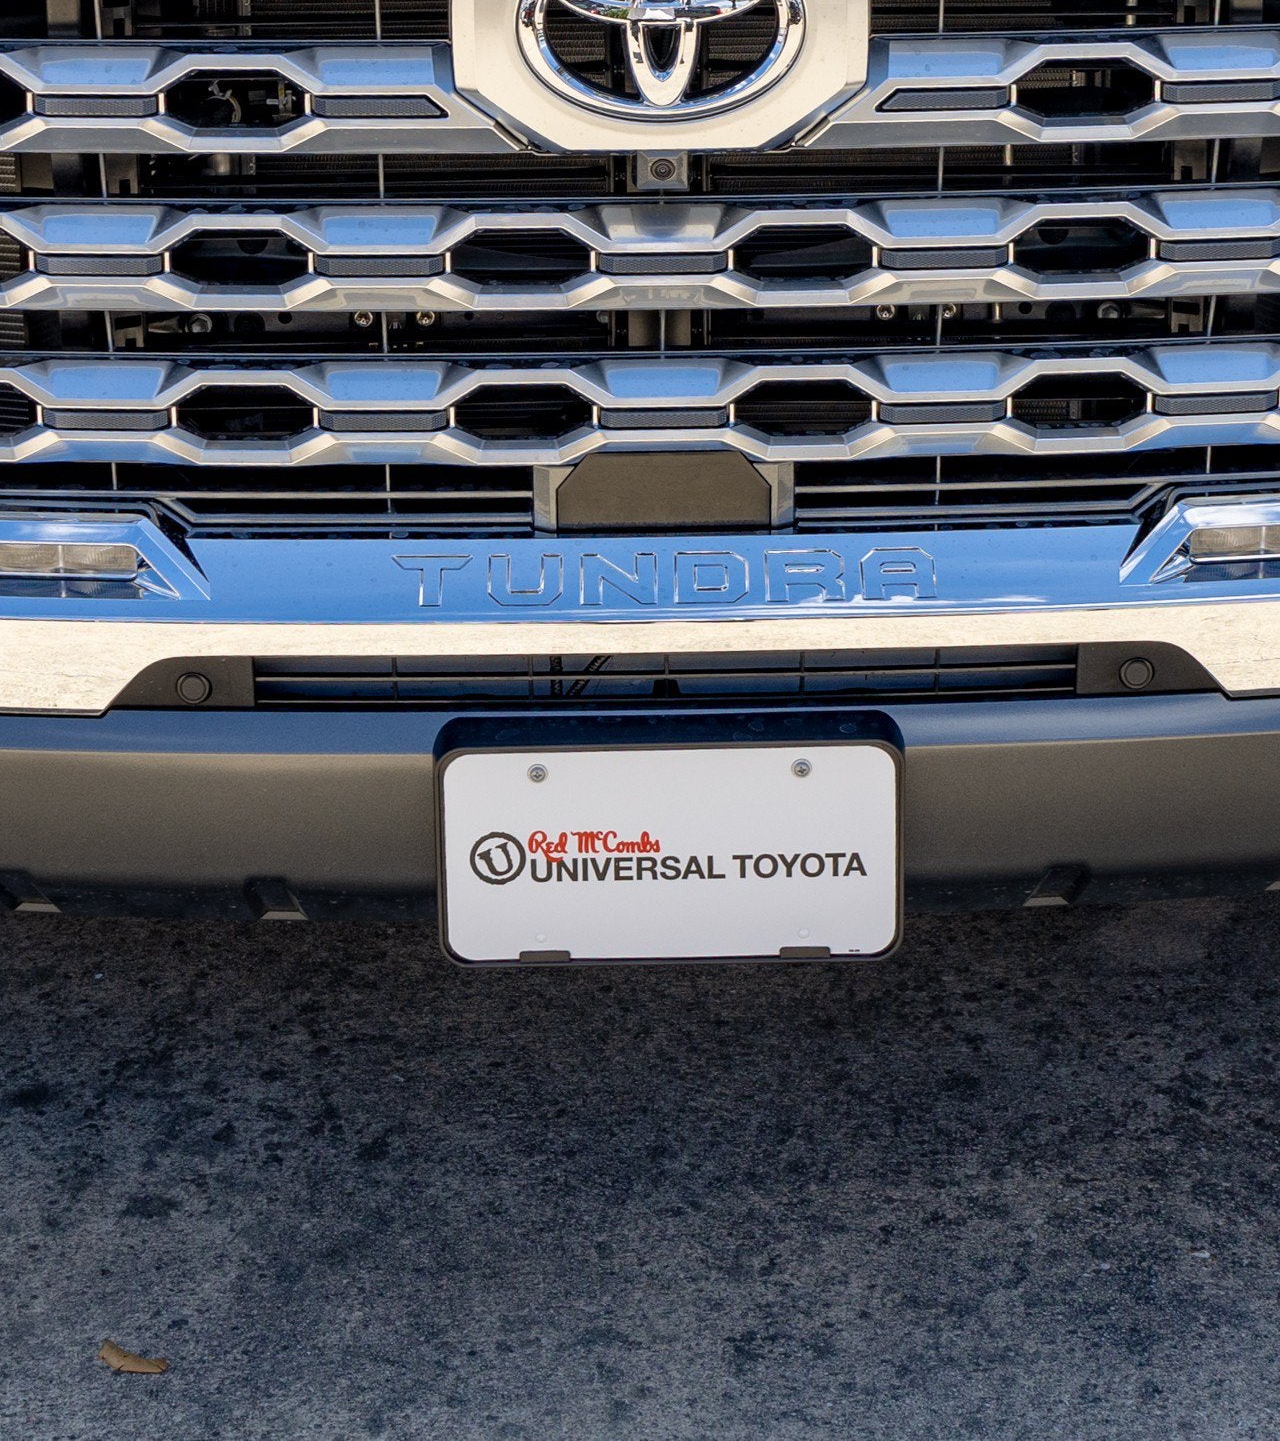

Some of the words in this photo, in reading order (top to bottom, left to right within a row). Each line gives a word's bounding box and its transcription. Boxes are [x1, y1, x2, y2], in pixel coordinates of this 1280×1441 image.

[391, 547, 938, 607] TUNDRA
[528, 830, 568, 862] Red
[571, 830, 661, 854] McCombs
[530, 855, 726, 883] UNIVERSAL
[732, 852, 868, 879] TOYOTA
